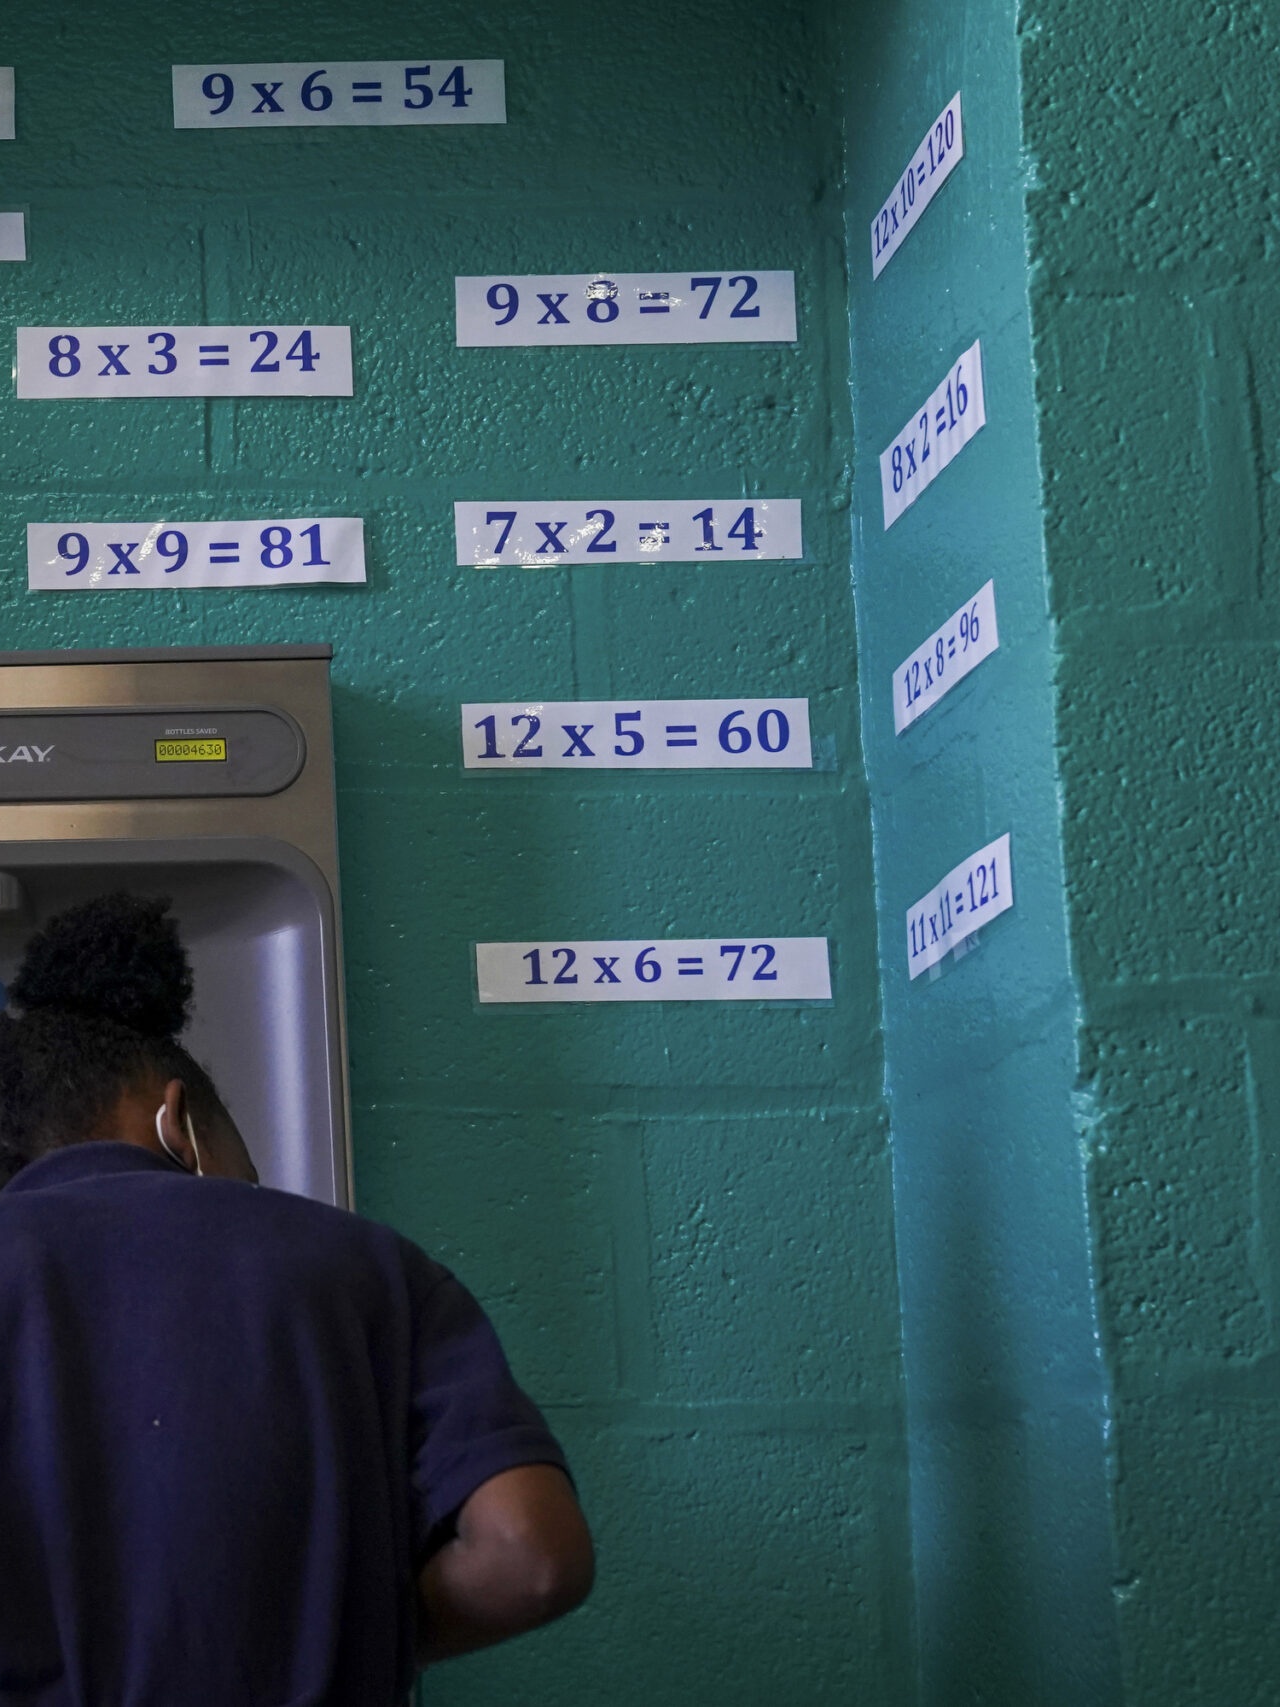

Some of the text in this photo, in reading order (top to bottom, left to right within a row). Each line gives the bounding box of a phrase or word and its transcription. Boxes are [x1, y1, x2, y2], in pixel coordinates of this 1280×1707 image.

[202, 65, 472, 114] 9 x 6 = 54
[487, 276, 760, 325] 9 x 8 = 72
[49, 331, 320, 377] 8 x 3 = 24
[891, 445, 903, 493] 8
[905, 438, 917, 479] x
[920, 412, 930, 462] 2
[58, 526, 330, 575] 9 x 9 = 81
[486, 507, 763, 553] 7 x 2 = 14
[904, 602, 980, 708] 12 x 8 = 96
[159, 744, 222, 756] 00004630
[196, 727, 218, 735] SAVED
[475, 709, 789, 758] 12 x 5 = 60
[523, 945, 777, 984] 12 x 6 = 72
